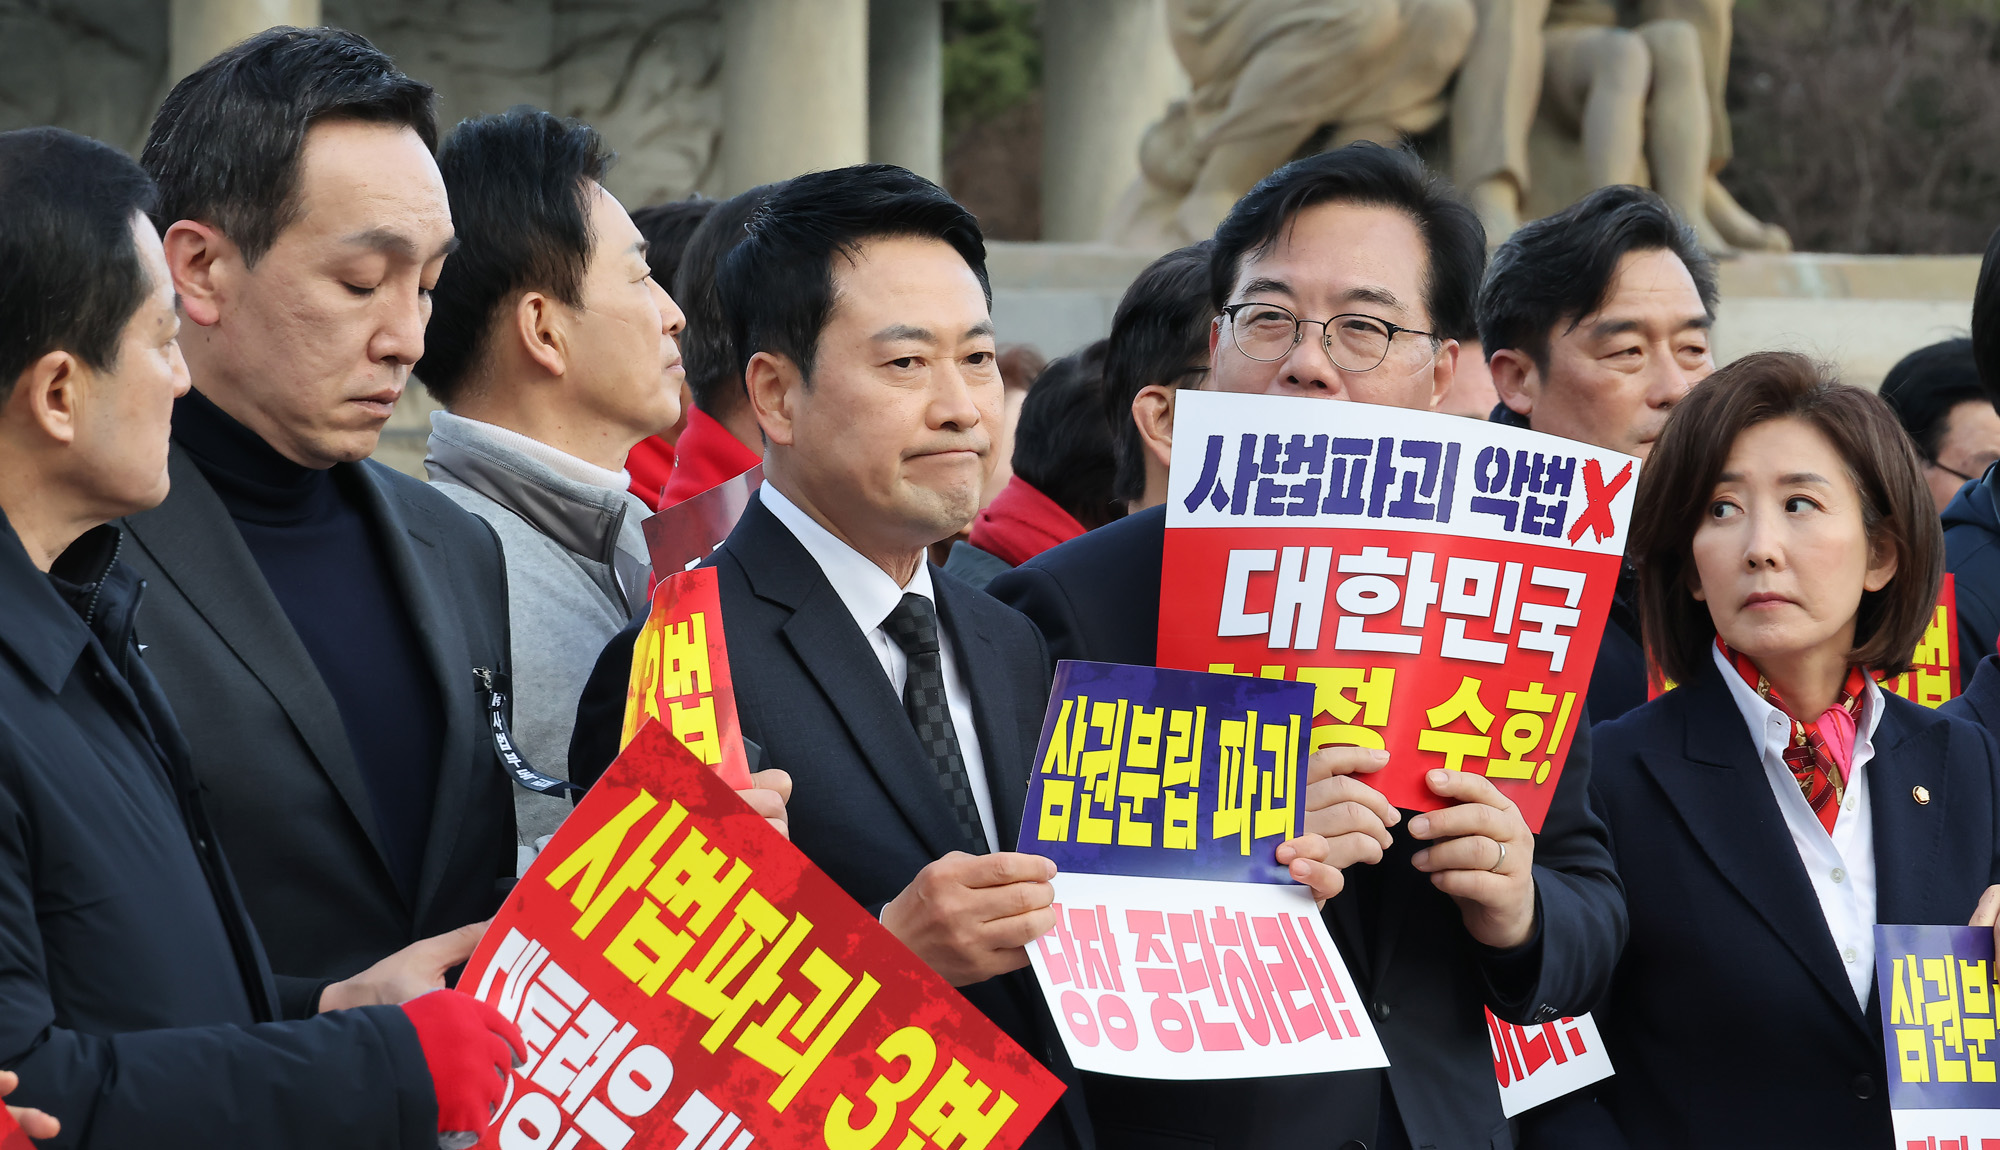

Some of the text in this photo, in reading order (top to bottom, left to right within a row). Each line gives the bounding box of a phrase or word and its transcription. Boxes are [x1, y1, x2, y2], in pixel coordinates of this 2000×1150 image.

[1184, 433, 1577, 538] 사법파괴 악법
[1217, 546, 1587, 672] 대한민국
[1037, 695, 1301, 857] 삼권분립 파괴
[1207, 663, 1577, 786] 정 수호!
[545, 787, 881, 1113] 사법파괴
[1036, 902, 1138, 1052] 당장
[1125, 906, 1360, 1053] 중단하라!
[1890, 954, 2000, 1083] 삼권분
